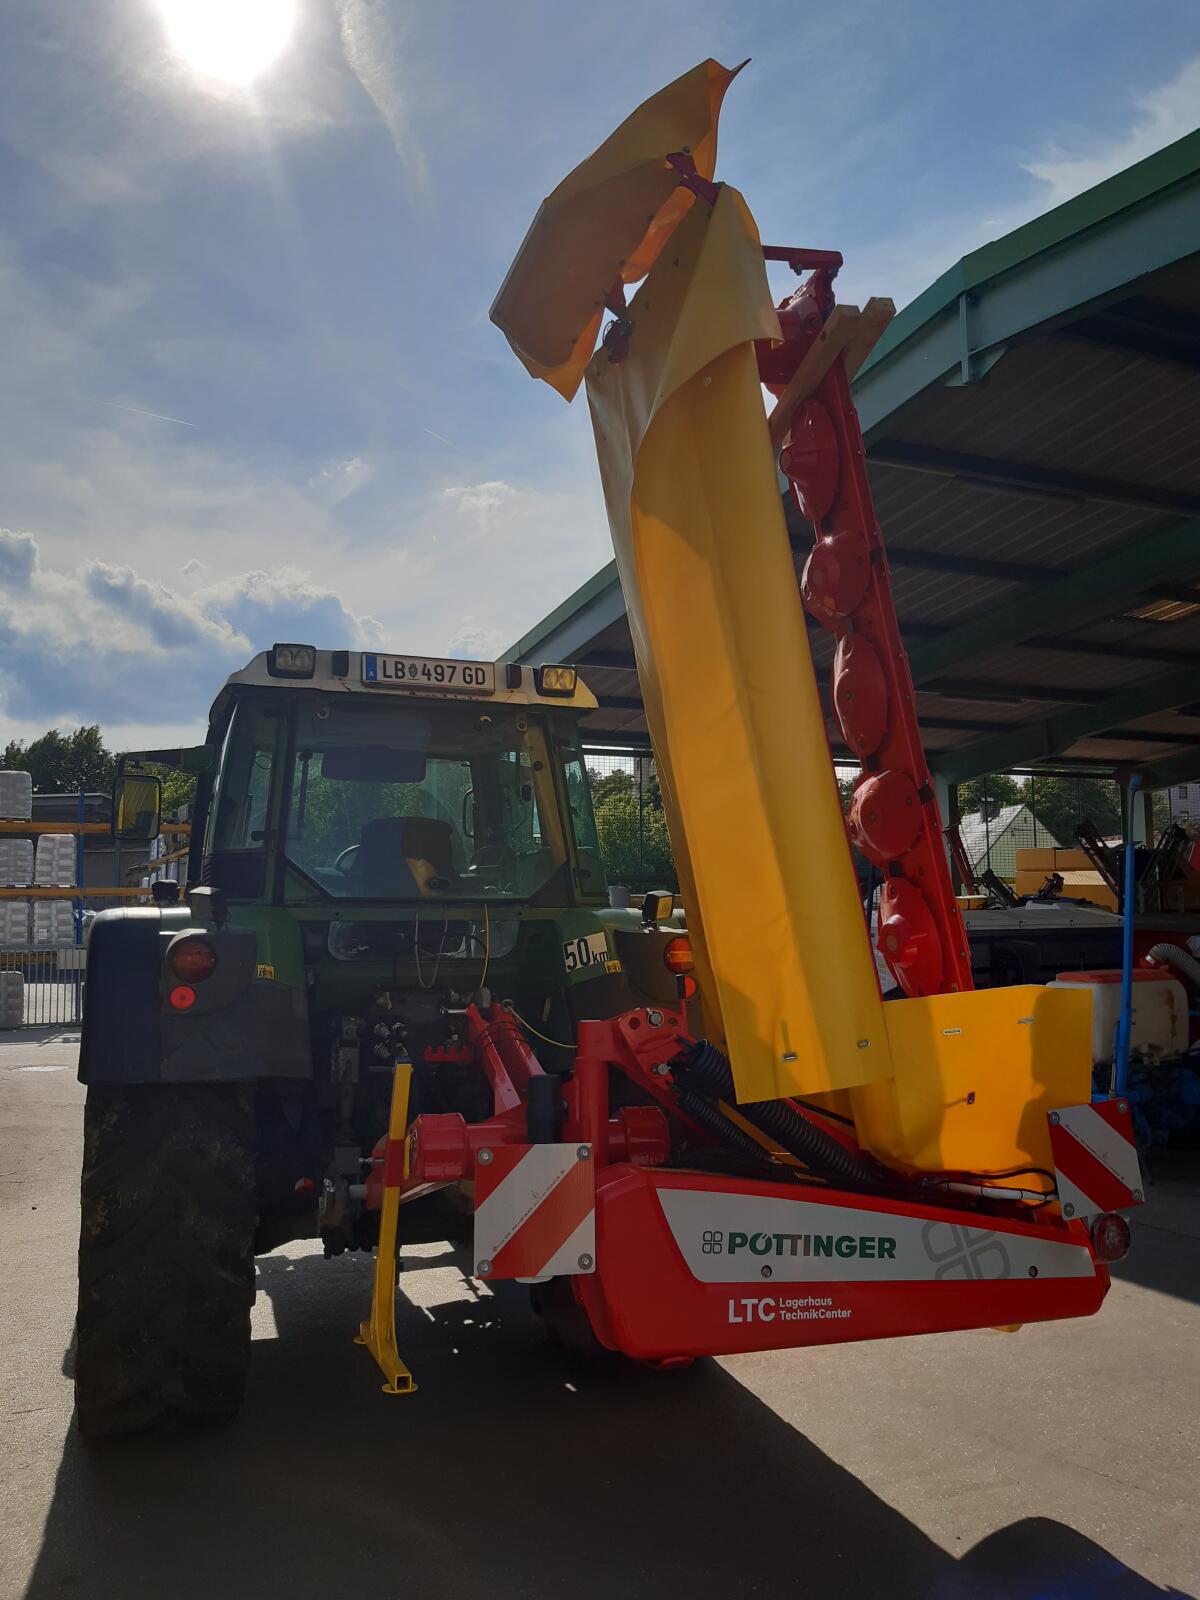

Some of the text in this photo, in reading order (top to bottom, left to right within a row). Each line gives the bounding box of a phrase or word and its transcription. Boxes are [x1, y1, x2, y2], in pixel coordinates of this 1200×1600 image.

[382, 659, 486, 685] LB 497 GD
[563, 937, 591, 971] 50
[727, 1231, 897, 1259] PÖTTINGER
[728, 1297, 776, 1323] LTC
[779, 1296, 833, 1309] Lagerhaus
[779, 1308, 852, 1321] TechnikCenter
